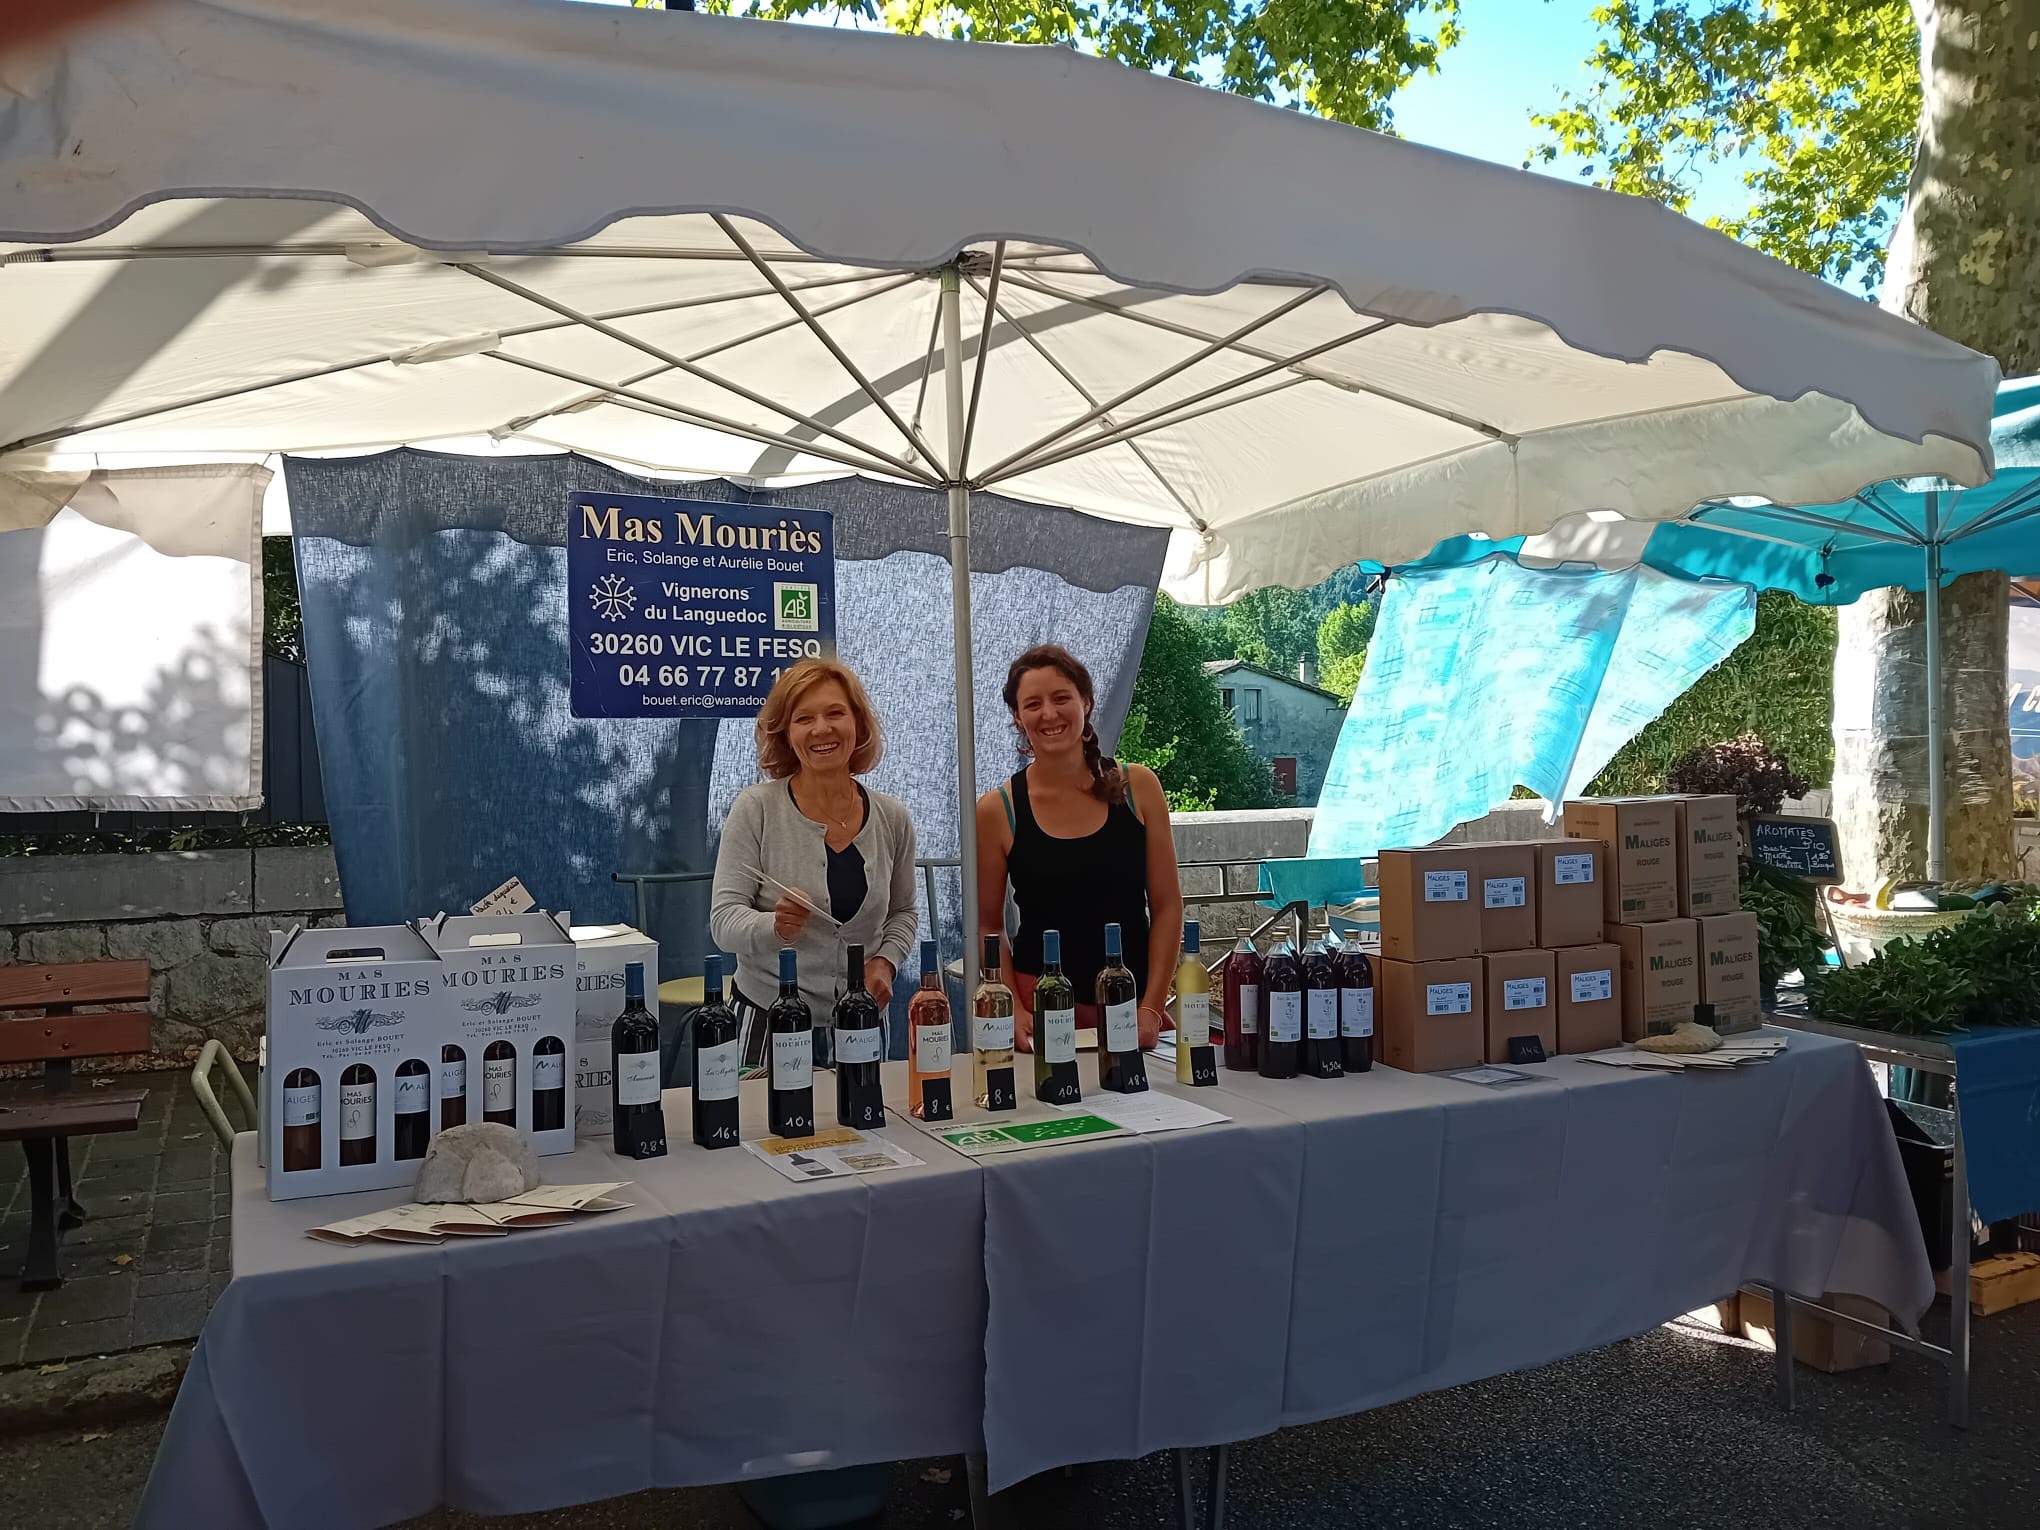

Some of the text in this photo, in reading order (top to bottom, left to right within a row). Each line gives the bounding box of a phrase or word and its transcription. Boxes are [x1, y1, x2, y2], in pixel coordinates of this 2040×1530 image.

[580, 505, 822, 553] Mas Mouriès
[607, 548, 804, 572] Eric, Solange et Aurélie Bouet
[662, 582, 750, 601] Vignerons
[644, 605, 767, 625] du Languedoc
[783, 597, 807, 618] AB
[590, 633, 822, 659] 30260 VIC LE FESQ
[619, 665, 793, 687] 04 66 77 87 1
[1694, 829, 1733, 844] MALIGES
[1756, 824, 1815, 838] AROMATES
[1625, 835, 1670, 850] MALIGES
[1637, 858, 1660, 866] ROUGE
[481, 954, 522, 965] MAS
[1650, 955, 1693, 971] MALIGES
[1710, 951, 1753, 966] MALIGES
[338, 969, 383, 981] MAS
[442, 964, 564, 988] MOURIES
[1662, 978, 1684, 987] ROUGE
[1721, 973, 1744, 982] ROUGE
[288, 979, 430, 1006] MOURIES
[378, 1034, 405, 1042] BOUET
[484, 1071, 512, 1080] OURIES
[341, 1096, 373, 1106] OURIES
[346, 1090, 362, 1098] MAS
